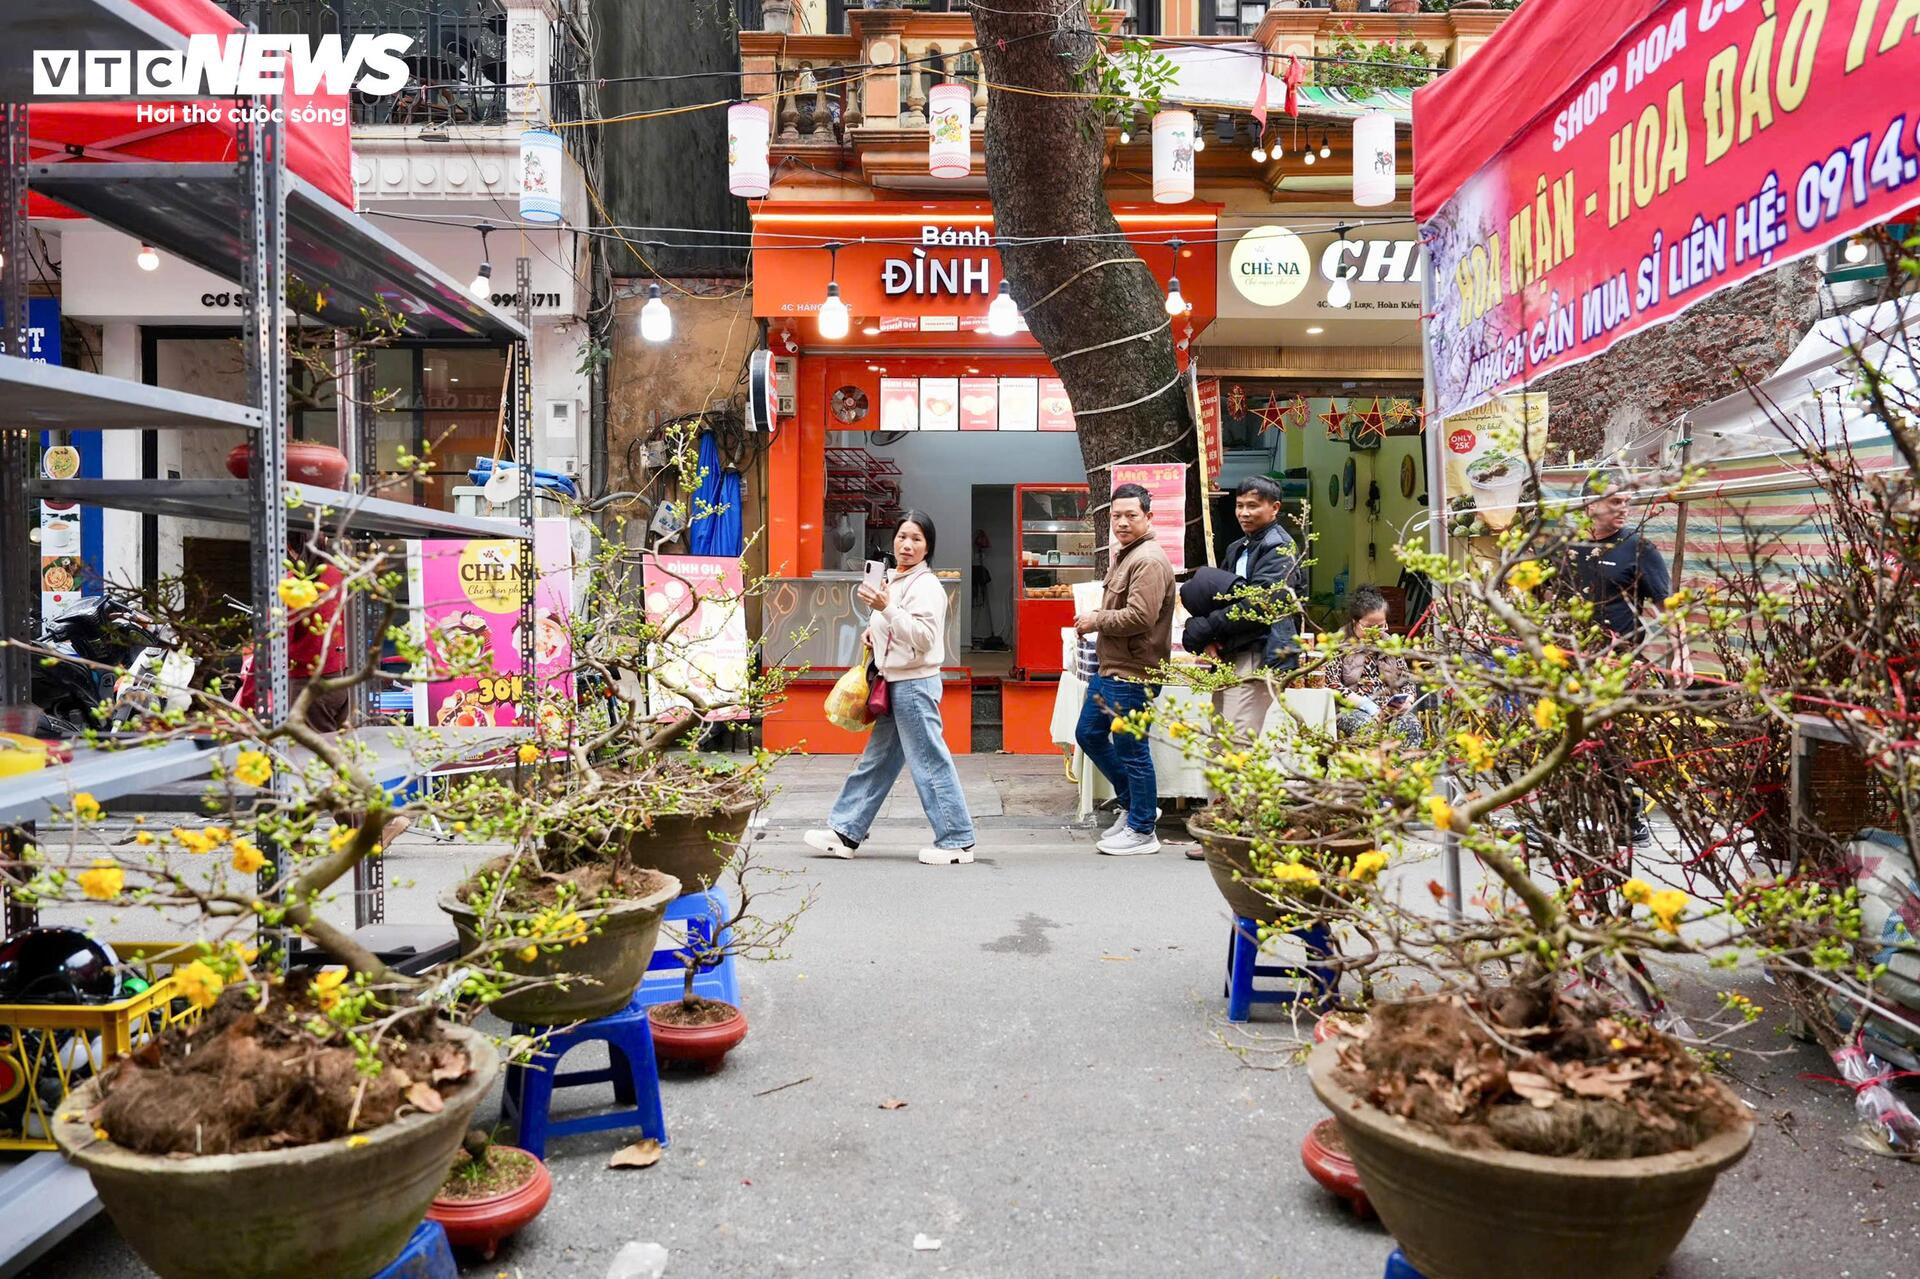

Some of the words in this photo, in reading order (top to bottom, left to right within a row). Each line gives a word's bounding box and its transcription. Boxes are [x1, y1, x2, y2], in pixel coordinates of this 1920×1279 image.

[1552, 66, 1619, 153] SHOP
[1624, 19, 1688, 95] HOA
[1455, 230, 1503, 333] HOA
[1508, 172, 1576, 295] MẬN
[1608, 81, 1690, 230] HOA
[922, 225, 990, 246] Bánh
[881, 247, 990, 295] ĐÌNH
[1241, 257, 1274, 276] CHÈ
[1277, 262, 1301, 276] NA
[1529, 288, 1576, 367] CẦN
[1580, 268, 1632, 343] MUA
[1635, 228, 1664, 312] SỈ
[1667, 217, 1727, 297] LIÊN
[1735, 169, 1789, 268] HỆ:
[201, 292, 231, 308] CƠ
[1317, 301, 1328, 309] 4C
[1377, 300, 1399, 309] Hoàn
[1451, 434, 1473, 443] ONLY
[1455, 442, 1471, 450] 25K
[460, 557, 505, 581] CHÈ
[700, 563, 722, 575] GIA
